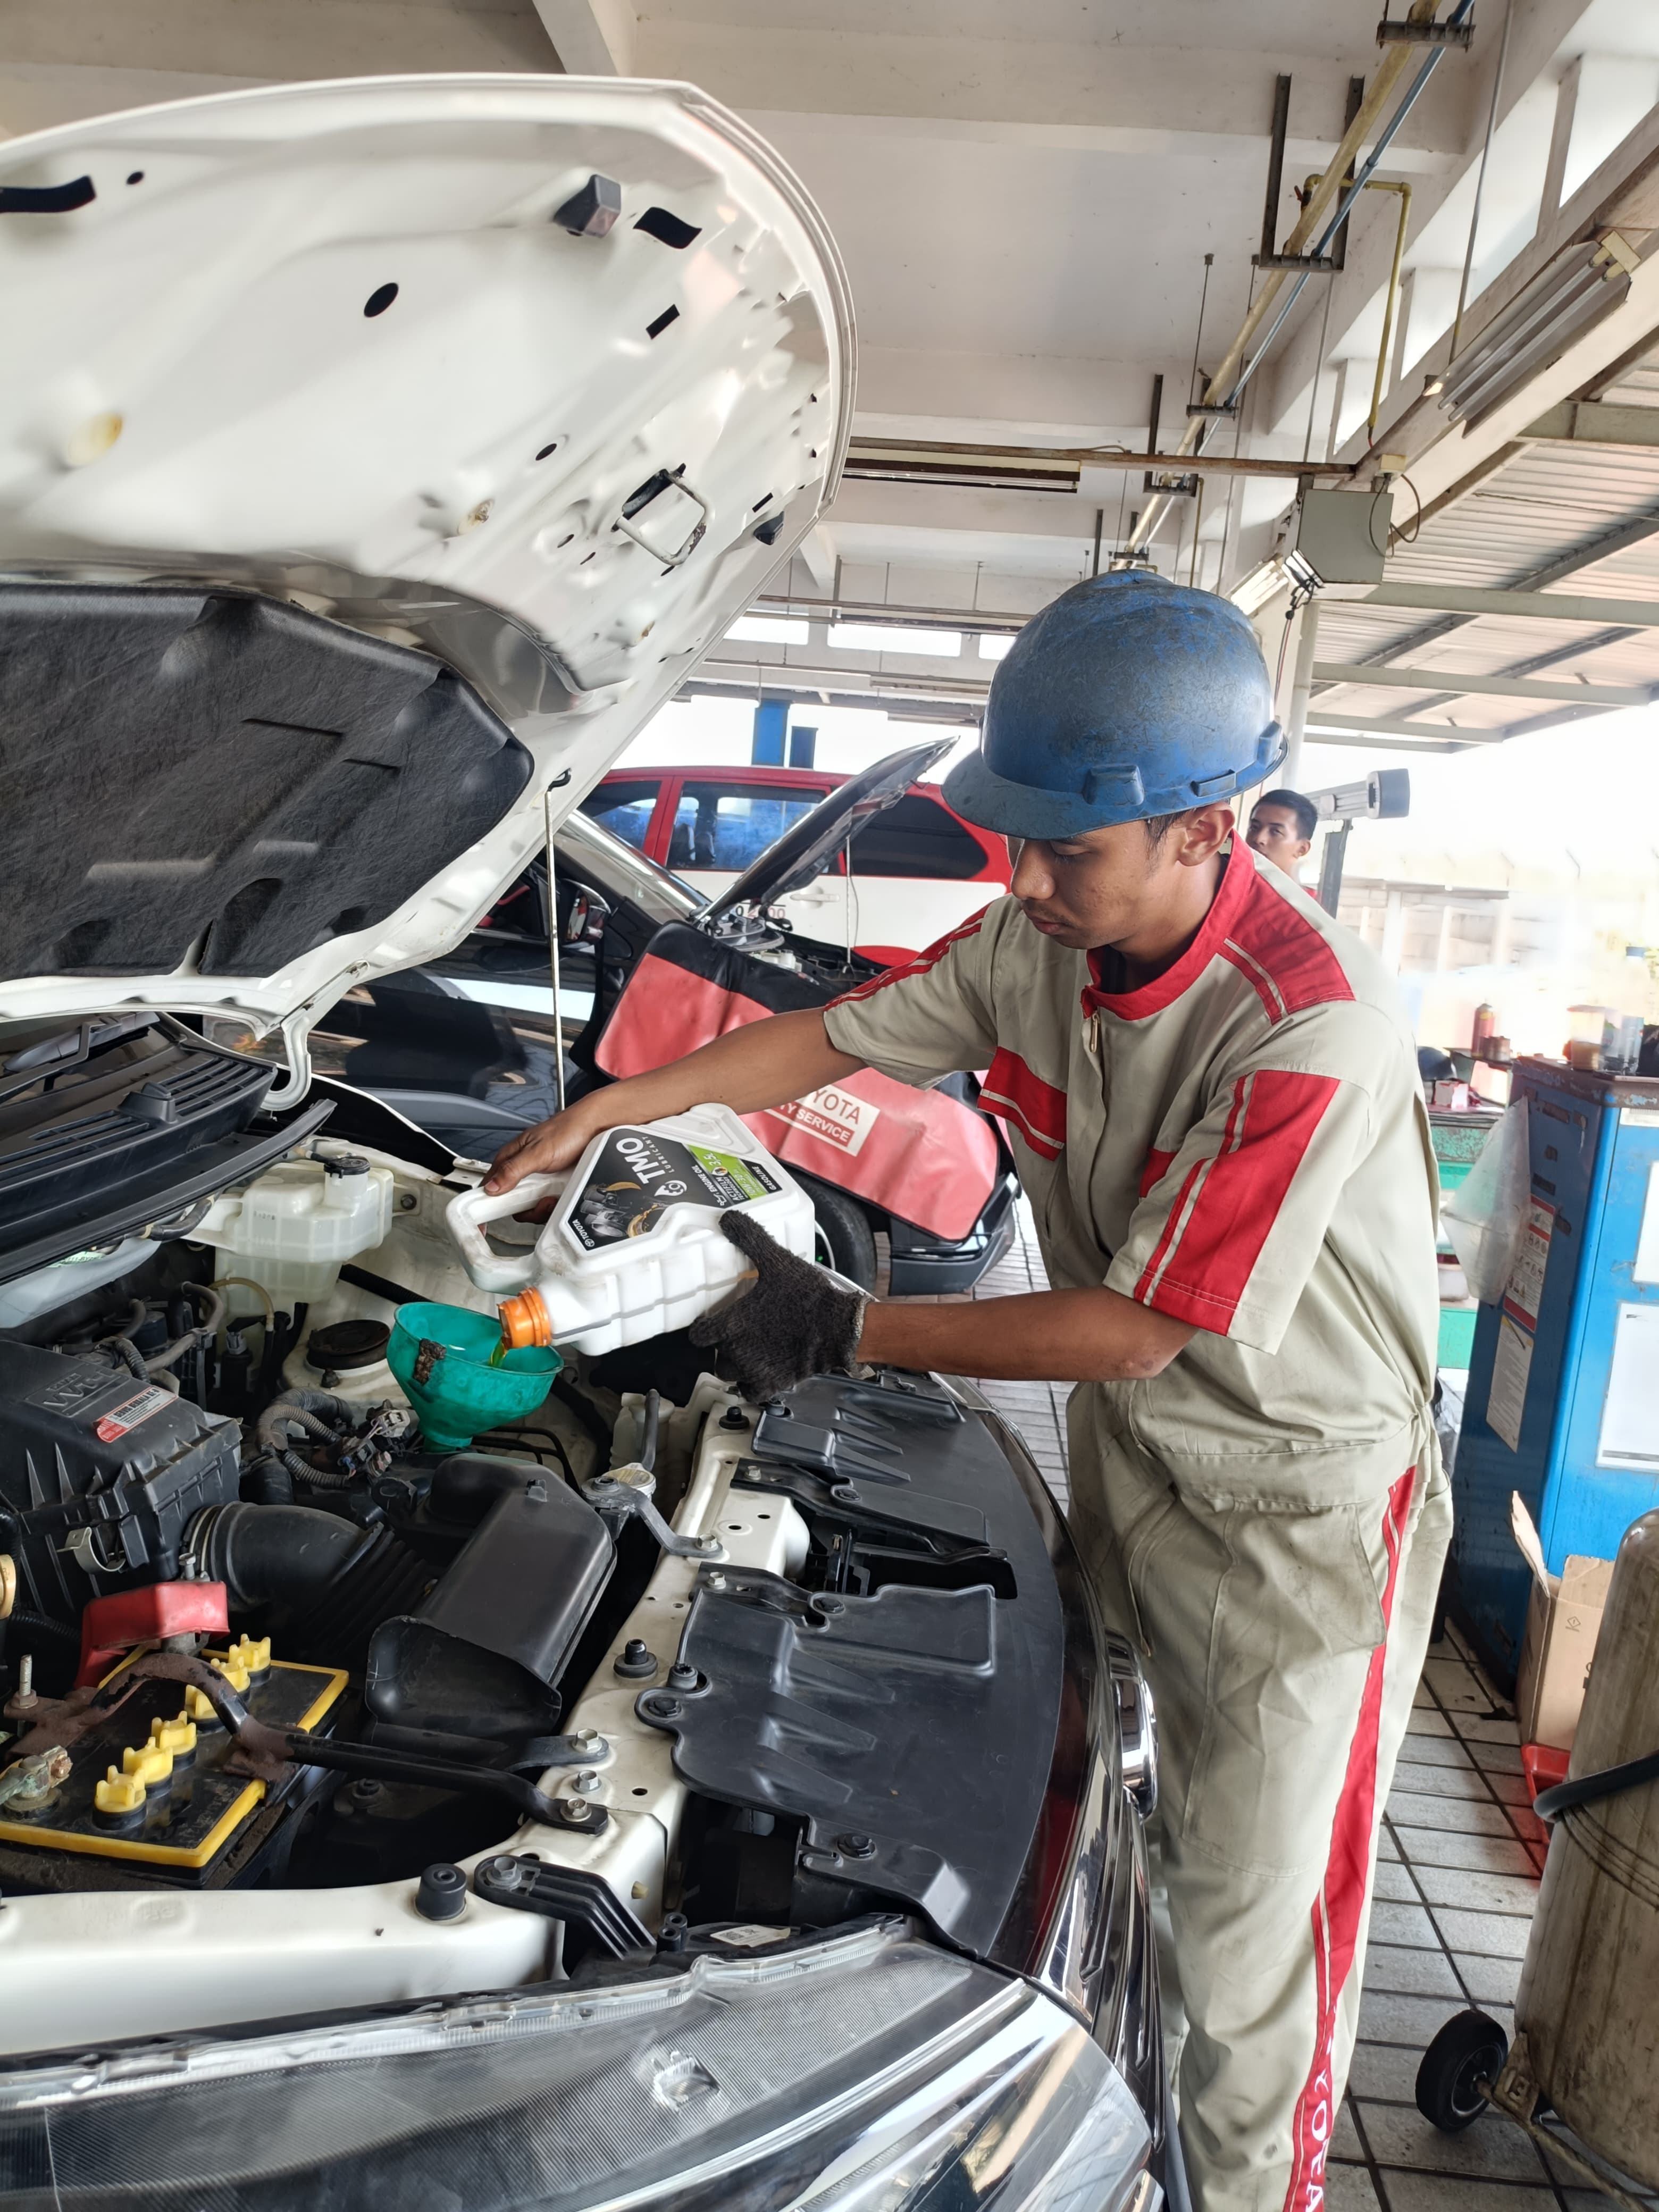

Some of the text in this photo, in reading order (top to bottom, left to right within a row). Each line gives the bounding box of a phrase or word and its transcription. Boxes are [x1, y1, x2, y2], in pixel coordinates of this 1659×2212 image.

[811, 1090, 861, 1125] YOTA
[797, 1108, 851, 1143] SERVICE
[616, 1138, 665, 1184] TMO
[642, 1136, 674, 1173] LUBRICANT
[691, 1164, 718, 1192] ENGINE OIL
[716, 1177, 741, 1201] ACTIFILM
[723, 1177, 745, 1200] TECHNOLOGY
[752, 1166, 776, 1190] GASOLINE
[572, 1219, 589, 1240] TOYOTA
[1305, 2035, 1331, 2212] YOTA
